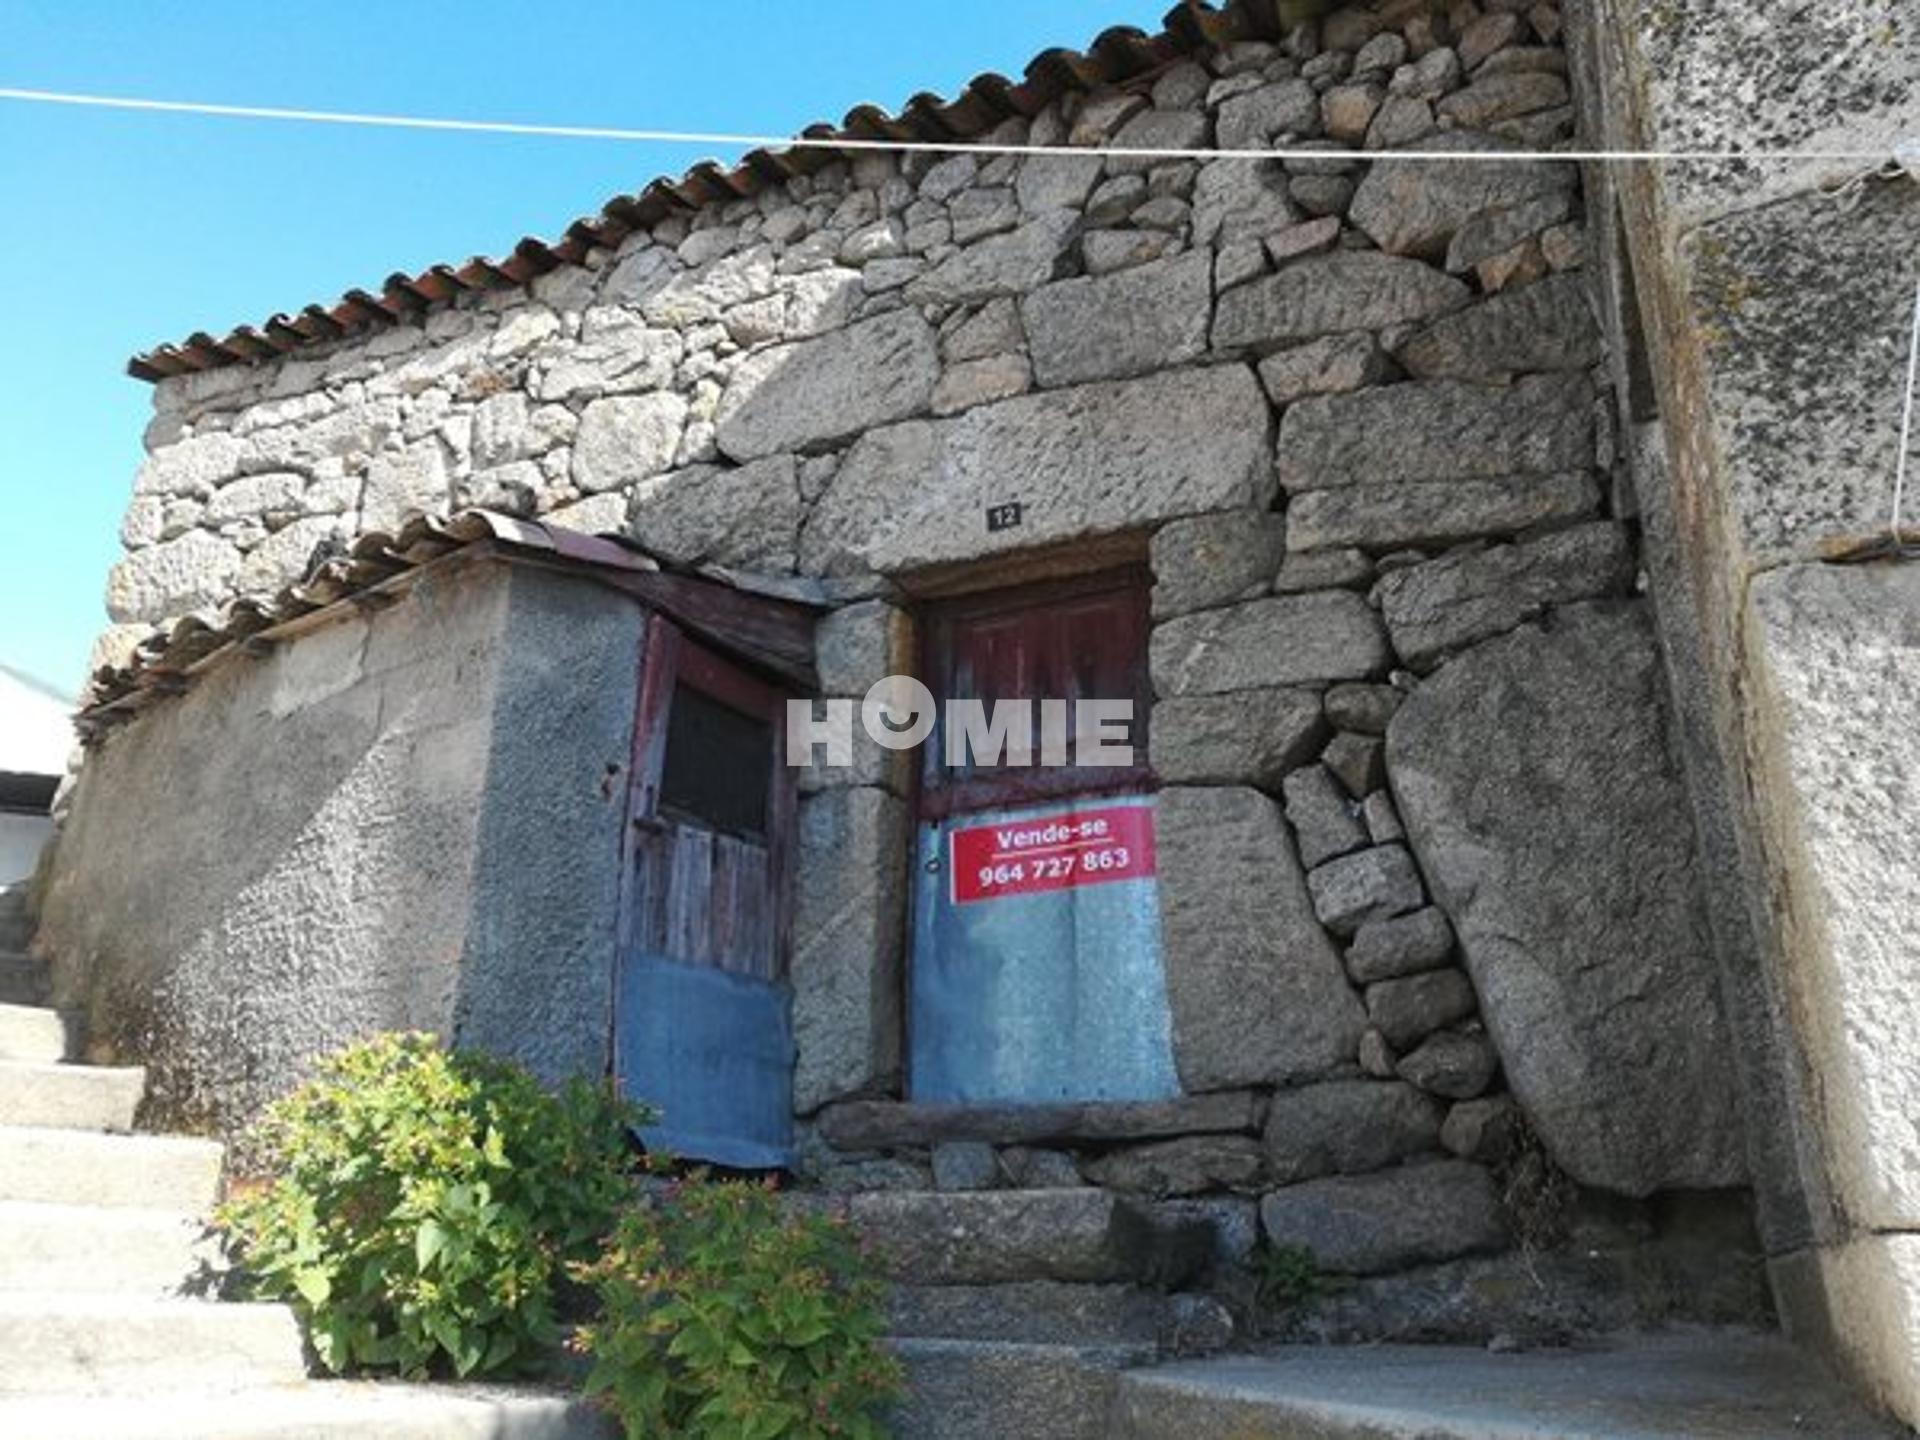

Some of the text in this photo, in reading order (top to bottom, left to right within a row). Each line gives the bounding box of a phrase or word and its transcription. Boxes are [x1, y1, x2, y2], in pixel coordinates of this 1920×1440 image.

[994, 507, 1016, 525] 12
[997, 818, 1108, 849] Vende-se
[978, 847, 1129, 887] 964 727 863
